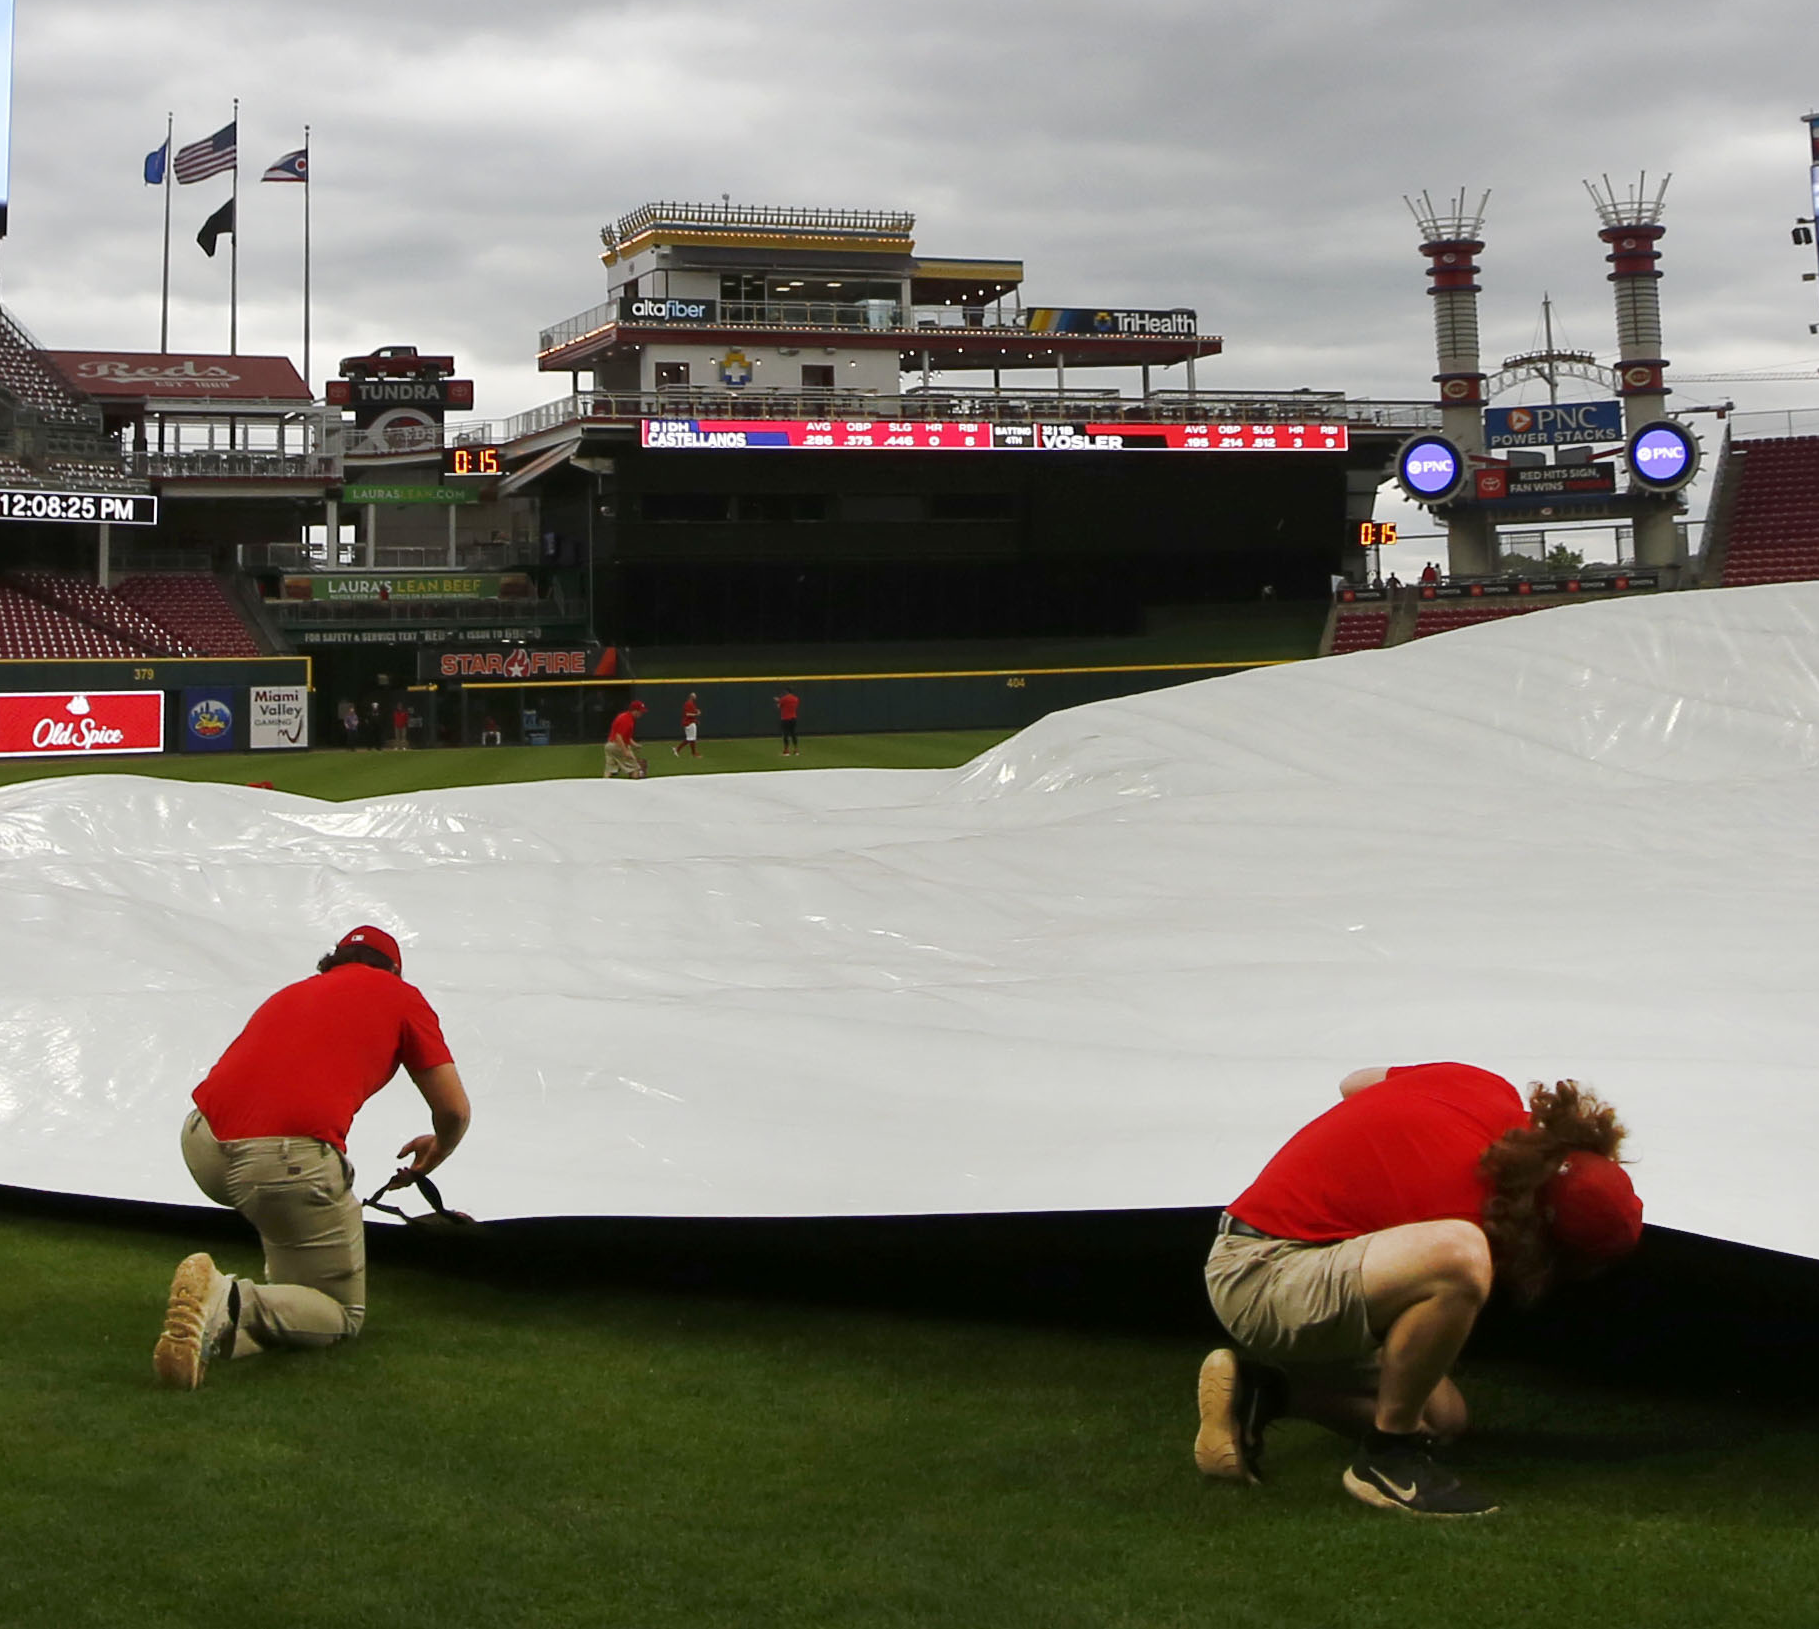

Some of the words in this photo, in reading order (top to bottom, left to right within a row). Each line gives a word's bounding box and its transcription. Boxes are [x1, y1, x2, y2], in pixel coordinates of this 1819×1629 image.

[631, 298, 706, 321] altafiber
[1113, 310, 1196, 334] TriHealth
[77, 360, 241, 384] Reds
[358, 384, 441, 401] TUNDRA
[1537, 406, 1597, 429] PNC
[805, 422, 832, 432] AVG
[846, 422, 872, 432] OBP
[888, 423, 913, 432] SLG
[925, 423, 943, 432] HR
[958, 423, 978, 432] RBI
[994, 426, 1032, 436] BATTING
[1184, 425, 1209, 435] AVG
[1218, 425, 1242, 435] OBP
[1252, 425, 1274, 435] SLG
[1288, 426, 1305, 435] HR
[1319, 426, 1338, 435] RBI
[647, 432, 748, 448] CASTELLANOS
[802, 435, 834, 446] .286
[843, 435, 873, 446] .375
[1005, 436, 1023, 445] 4TH
[1041, 435, 1123, 450] VOSLER
[1184, 437, 1210, 448] .195
[1218, 437, 1244, 448] .214
[1251, 437, 1276, 448] .512
[1490, 431, 1548, 447] POWER
[1554, 428, 1616, 444] STACKS
[1653, 445, 1685, 459] PNC
[455, 449, 497, 474] 0:15
[1423, 459, 1454, 473] PNC
[1519, 470, 1542, 480] RED
[1543, 469, 1568, 479] HITS
[1569, 468, 1601, 478] SIGN,
[352, 488, 466, 500] LAURASLEAN.COM
[1509, 483, 1532, 493] FAN
[1534, 481, 1565, 491] WINS
[0, 494, 96, 520] 12:08:25
[100, 499, 134, 521] PM
[1359, 522, 1397, 546] 0:15
[328, 580, 393, 594] LAURA'S
[397, 580, 439, 593] LEAN
[442, 579, 482, 592] BEEF
[440, 653, 504, 676] STAR
[529, 651, 586, 675] FIRE
[134, 668, 155, 681] 379
[1005, 677, 1026, 689] 404
[254, 690, 299, 703] Miami
[260, 704, 303, 719] Valley
[253, 718, 293, 726] GAMING
[32, 717, 71, 746] Old
[71, 717, 124, 750] Spice
